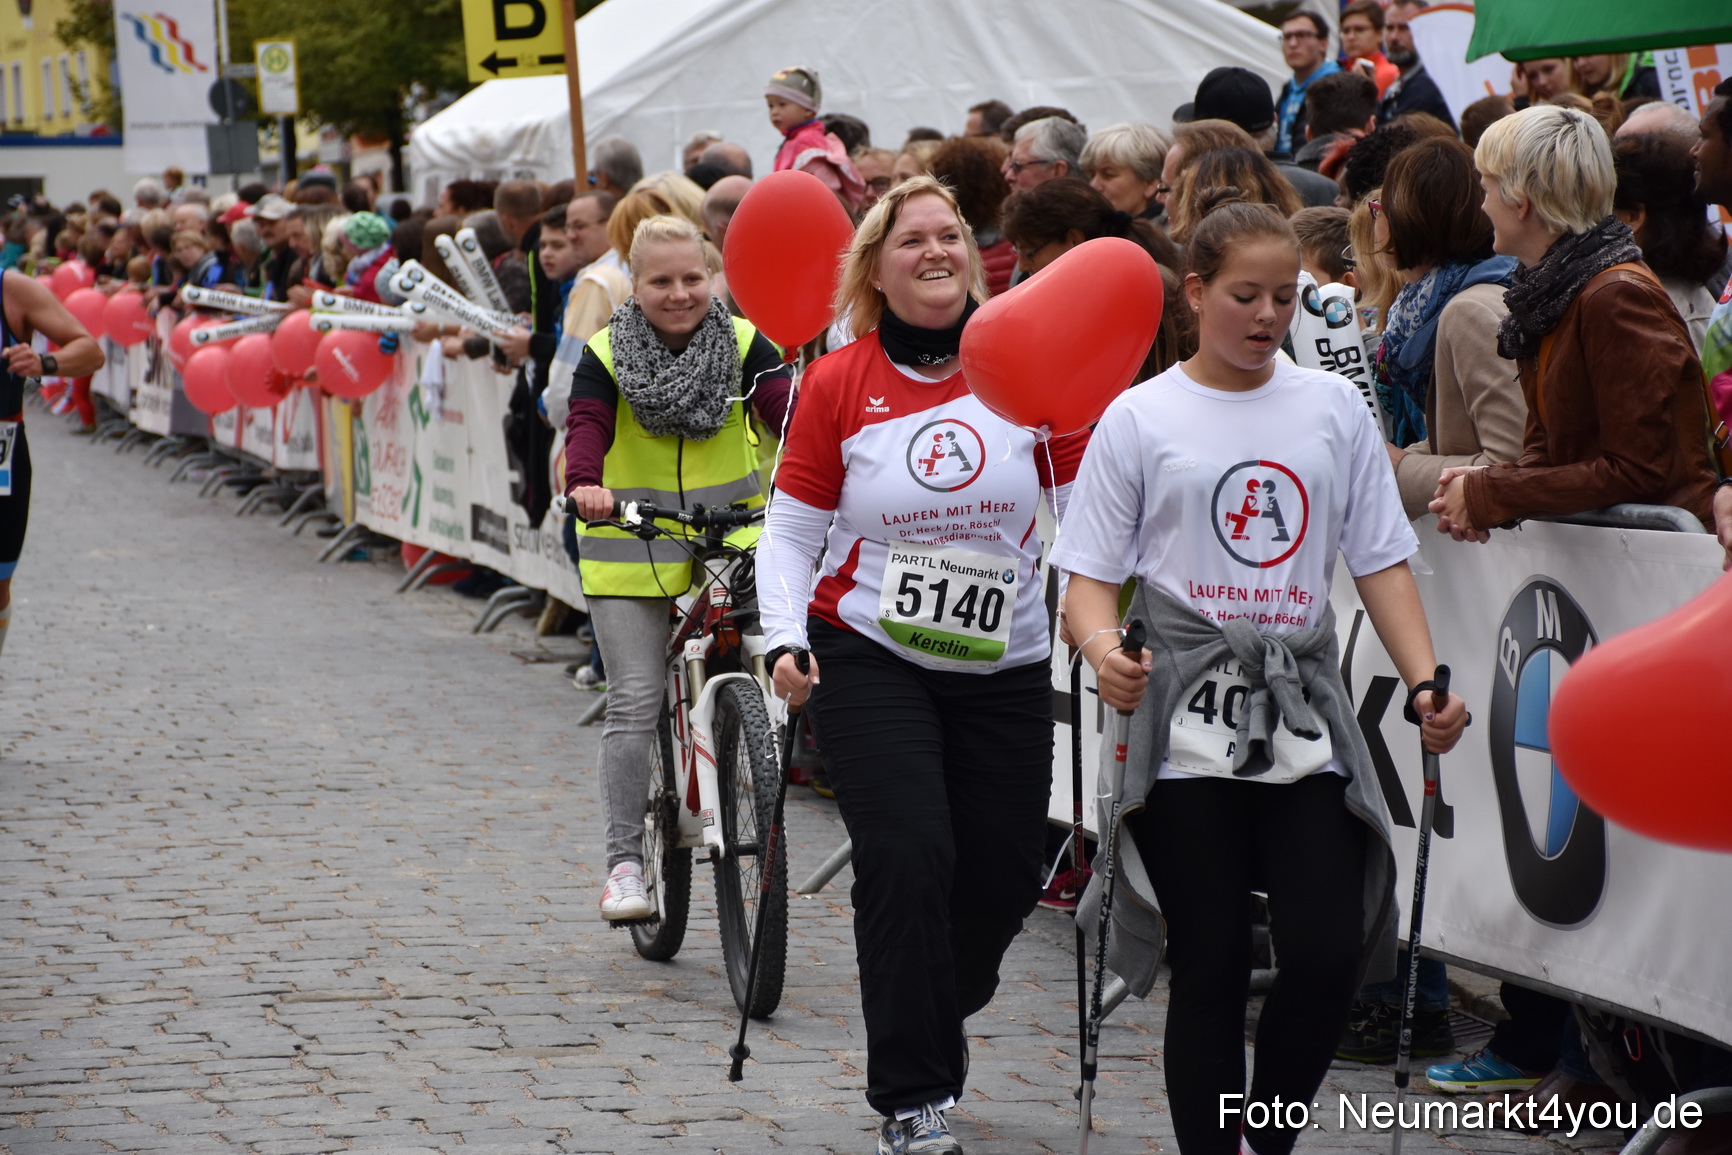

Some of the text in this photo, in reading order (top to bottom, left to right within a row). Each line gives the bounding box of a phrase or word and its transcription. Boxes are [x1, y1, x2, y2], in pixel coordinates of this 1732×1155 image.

[472, 258, 495, 290] BMW
[207, 292, 237, 306] BMW
[344, 300, 375, 315] BMW
[865, 405, 890, 413] erima
[882, 500, 1016, 526] LAUFEN MIT HERZ
[899, 530, 915, 538] Dr.
[916, 525, 942, 534] Heck
[952, 522, 967, 532] Dr.
[891, 552, 999, 580] PARTL Neumarkt
[895, 571, 1006, 633] 5140
[1189, 580, 1248, 602] LAUFEN
[1255, 588, 1283, 602] MIT
[908, 631, 970, 657] Kerstin
[1406, 931, 1420, 1019] ALUMINIUM
